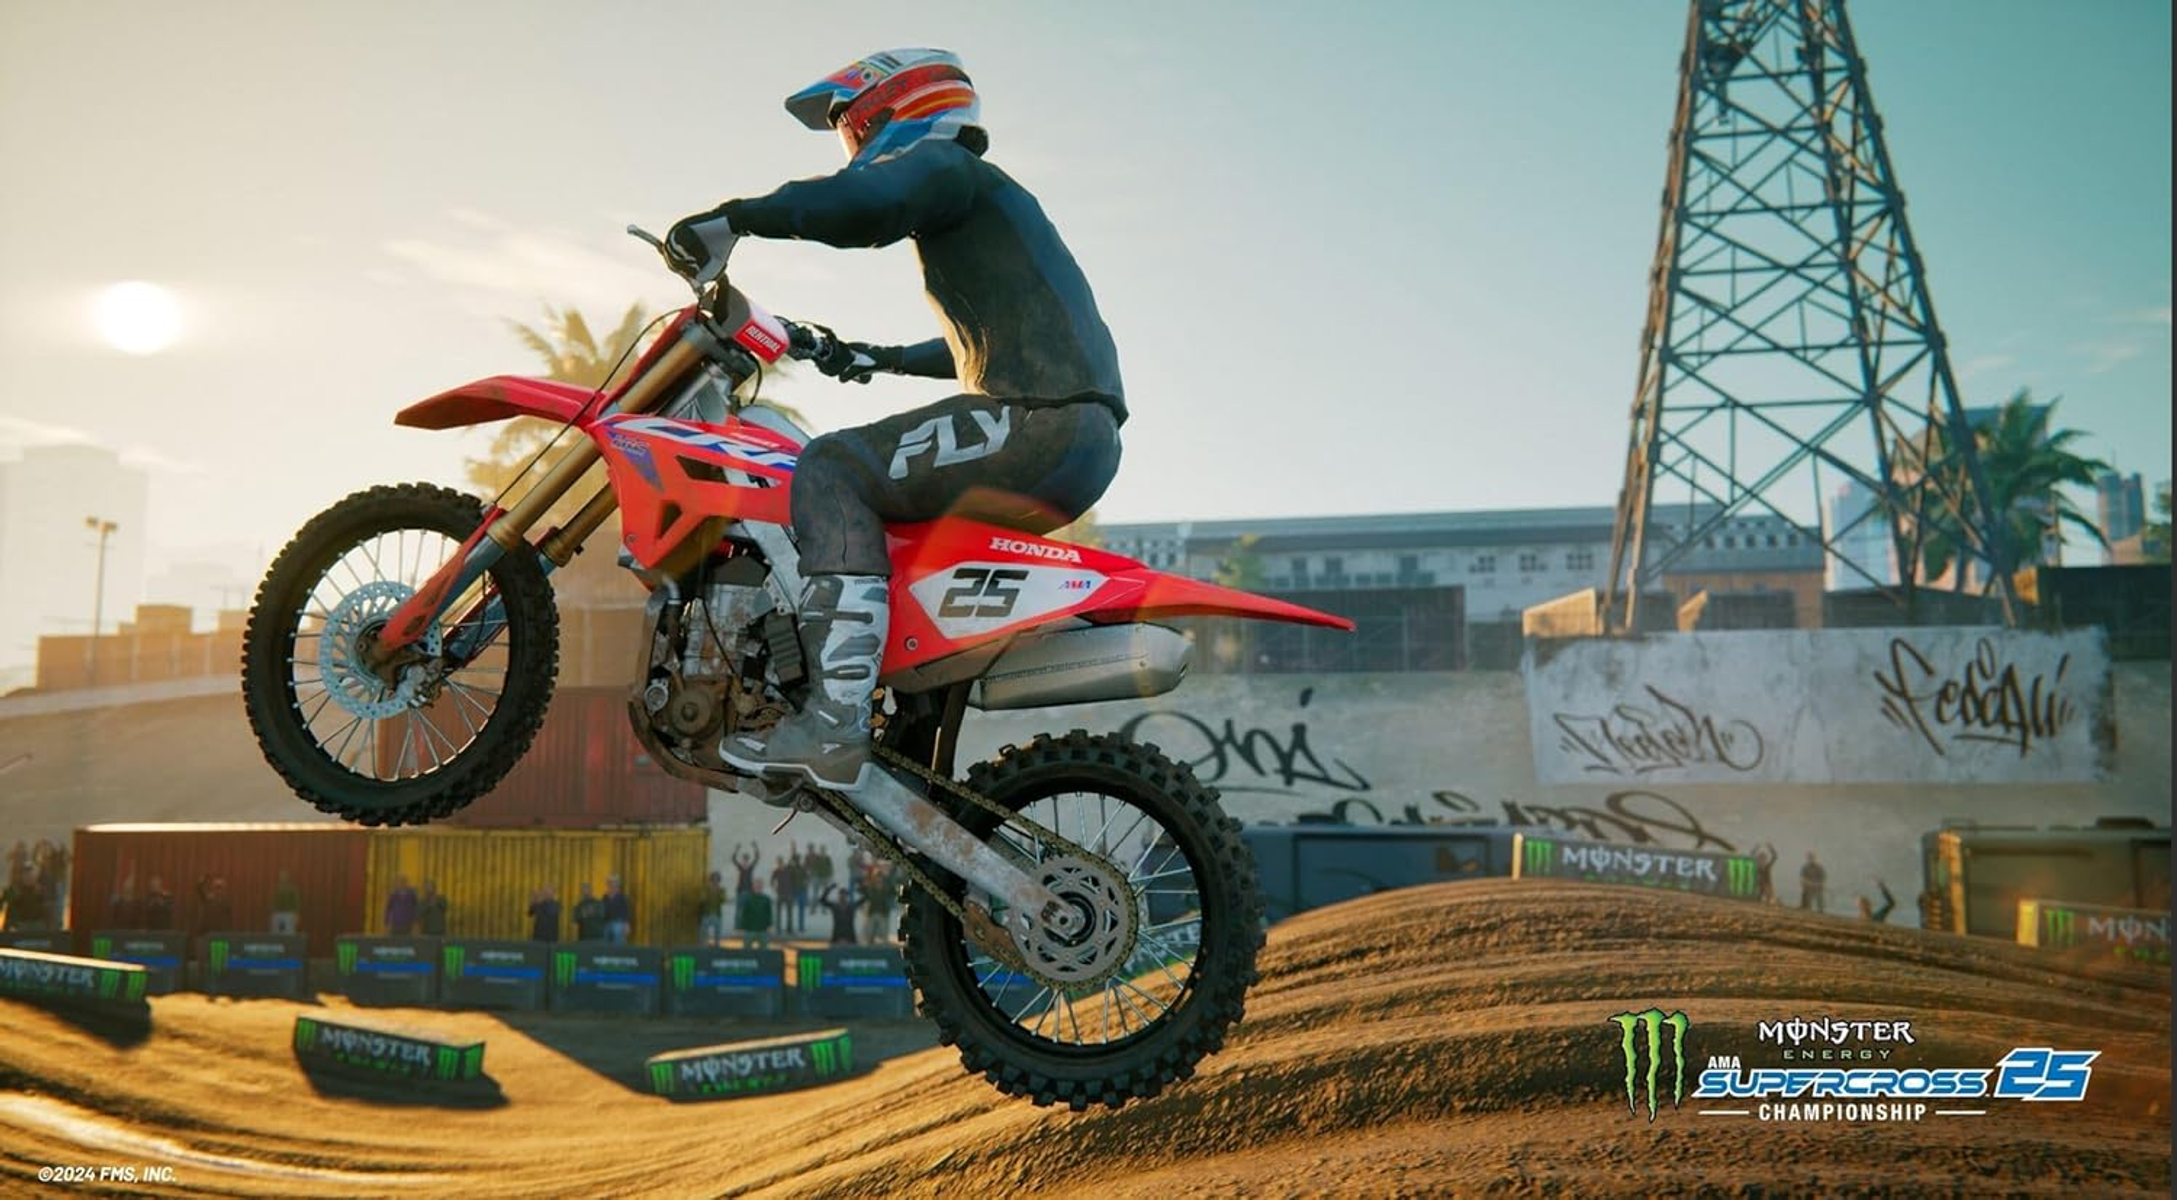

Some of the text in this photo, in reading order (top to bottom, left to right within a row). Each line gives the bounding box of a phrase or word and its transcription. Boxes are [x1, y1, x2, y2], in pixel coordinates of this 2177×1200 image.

[888, 405, 1011, 479] FLY
[989, 537, 1082, 563] HONDA
[938, 568, 1030, 618] 25
[1562, 846, 1719, 881] MONSTER
[321, 1027, 431, 1067] MONSTER
[680, 1047, 806, 1083] MONSTER
